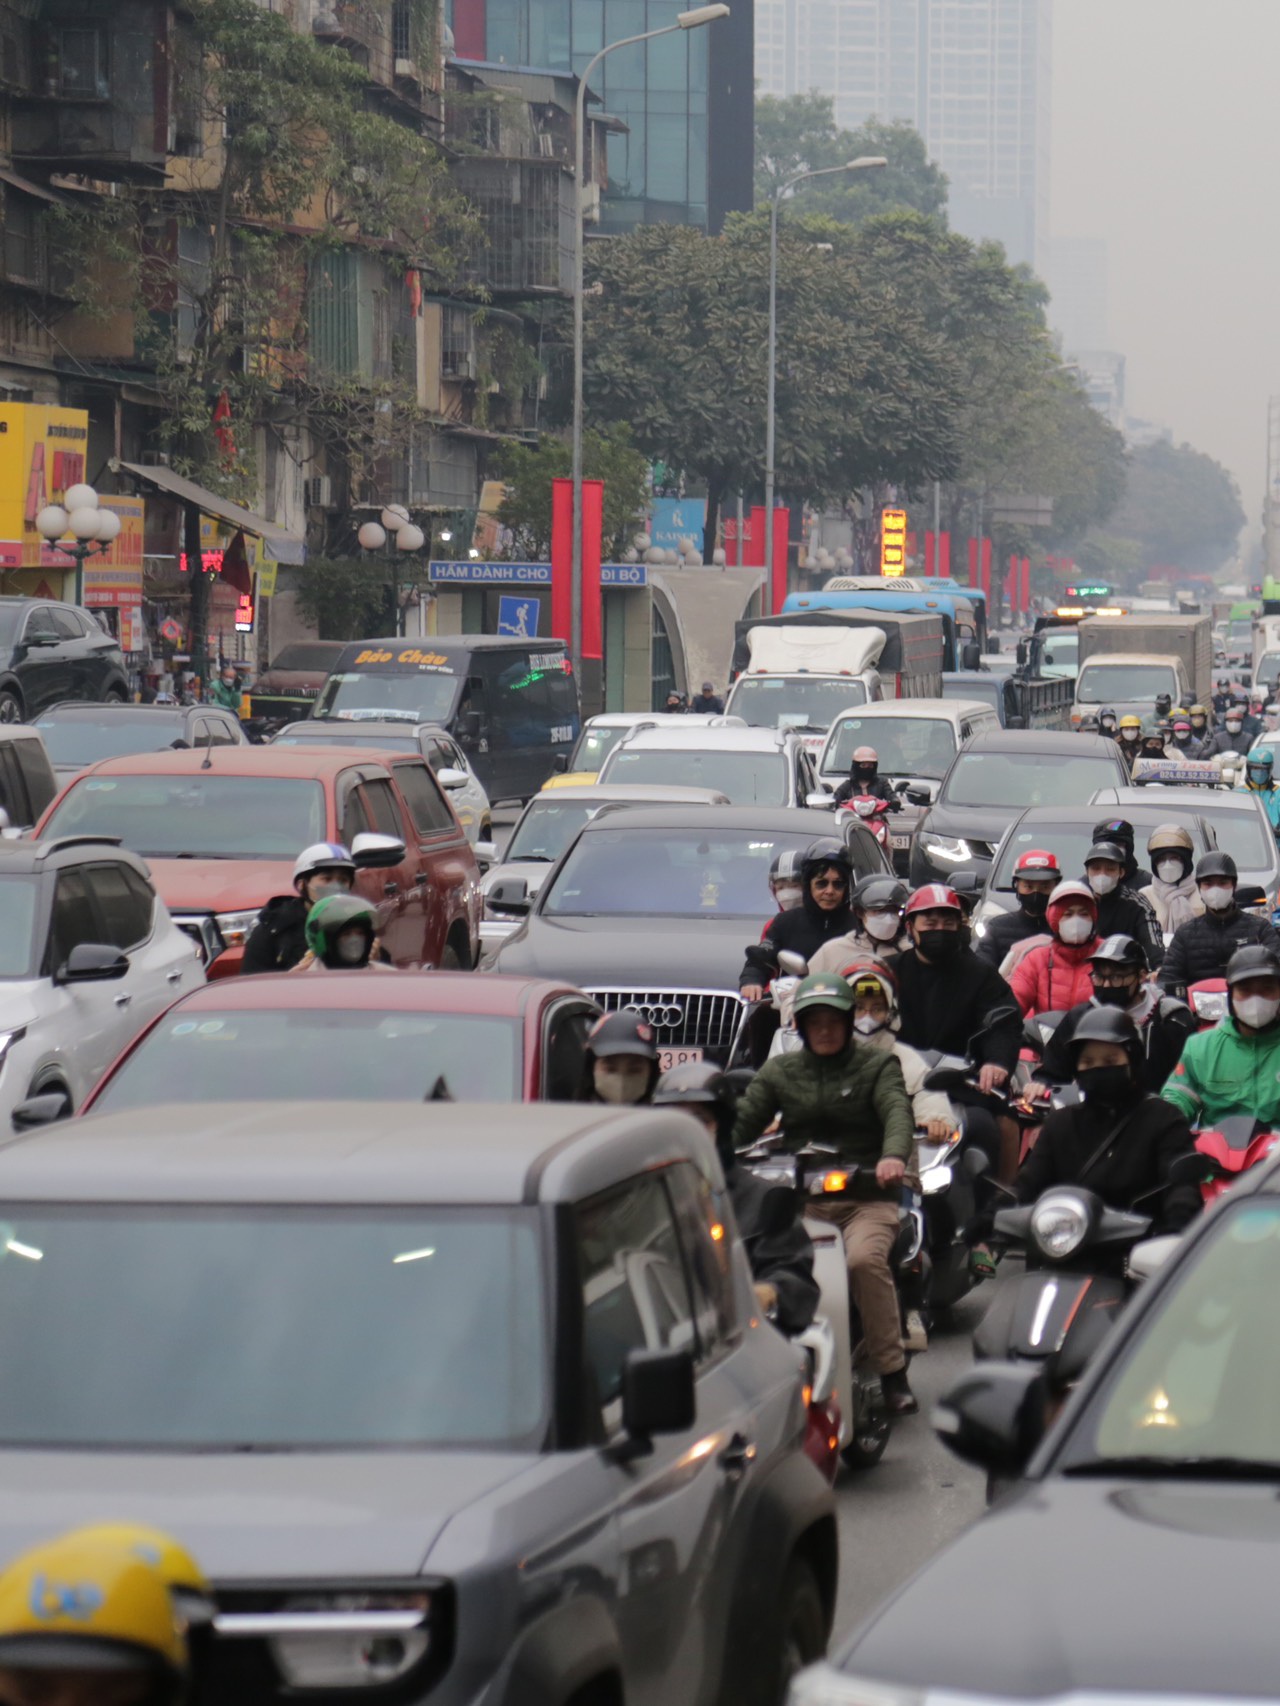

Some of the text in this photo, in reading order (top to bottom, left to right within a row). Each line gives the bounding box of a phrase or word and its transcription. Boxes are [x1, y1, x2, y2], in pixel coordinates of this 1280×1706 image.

[472, 564, 513, 579] DÀNH
[517, 567, 548, 580] CHO
[602, 569, 615, 581] ĐI
[619, 567, 640, 584] BỘ
